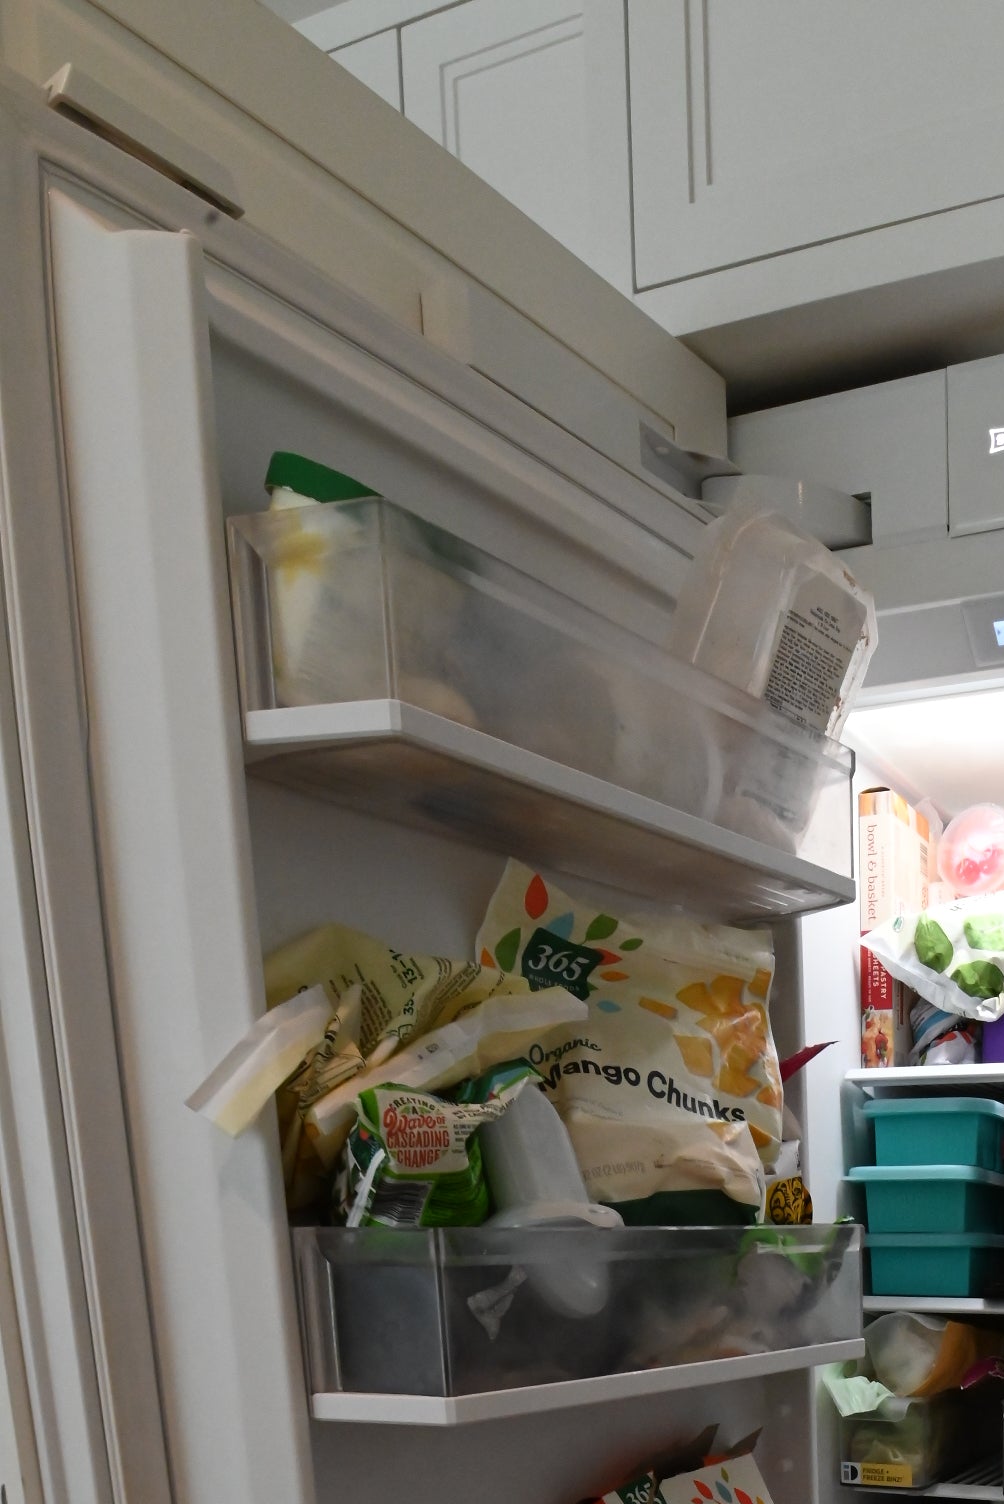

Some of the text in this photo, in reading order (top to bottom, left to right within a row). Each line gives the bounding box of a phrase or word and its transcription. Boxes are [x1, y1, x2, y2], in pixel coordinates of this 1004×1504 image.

[867, 824, 878, 859] bowl
[528, 944, 590, 981] 365
[529, 1038, 602, 1065] Organic
[537, 1059, 641, 1092] Mango
[647, 1070, 746, 1123] Chunks
[411, 1105, 419, 1115] A
[387, 1129, 450, 1150] CASCADING
[397, 1149, 441, 1168] CHANGE
